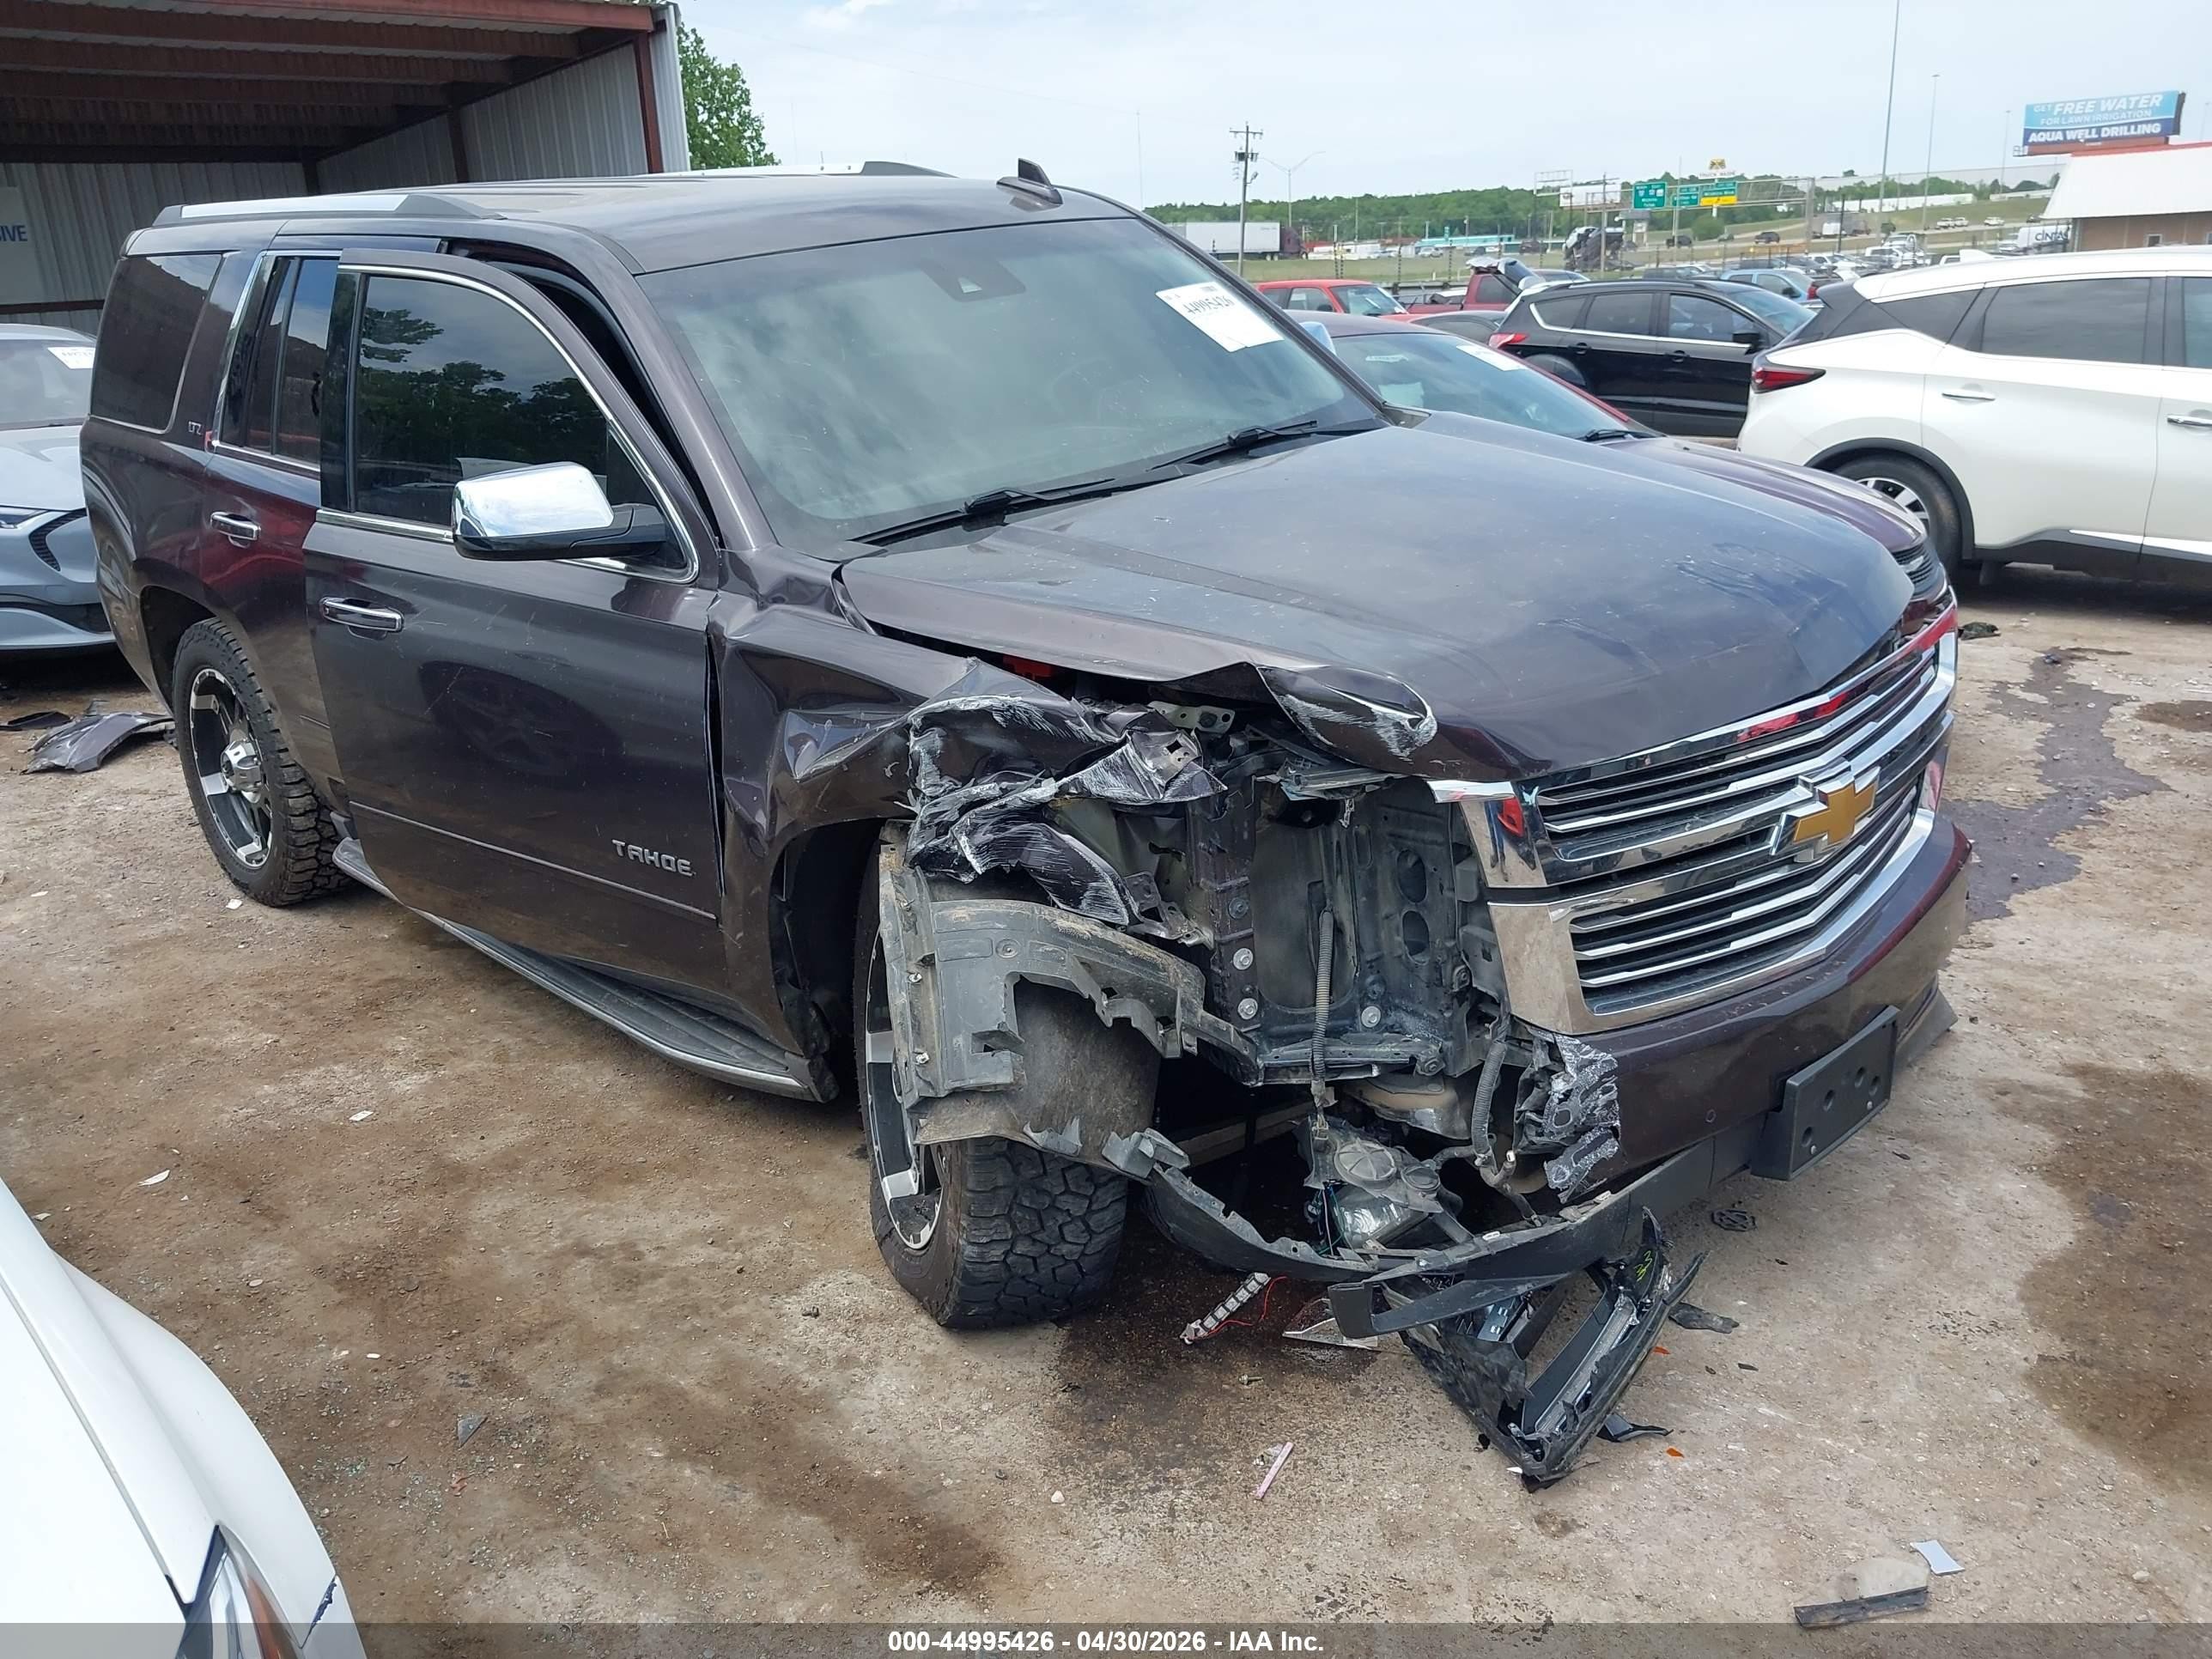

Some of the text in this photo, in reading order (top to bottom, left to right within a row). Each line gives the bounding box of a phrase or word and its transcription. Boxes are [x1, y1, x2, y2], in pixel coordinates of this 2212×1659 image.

[2054, 100, 2095, 115] FREE
[2100, 94, 2162, 111] WATER
[2062, 114, 2090, 125] LAWN
[2093, 111, 2151, 122] IRRIGATION
[2029, 124, 2160, 142] AQUA WELL DRILLING
[0, 225, 28, 241] IVE
[611, 839, 693, 877] TAHOE
